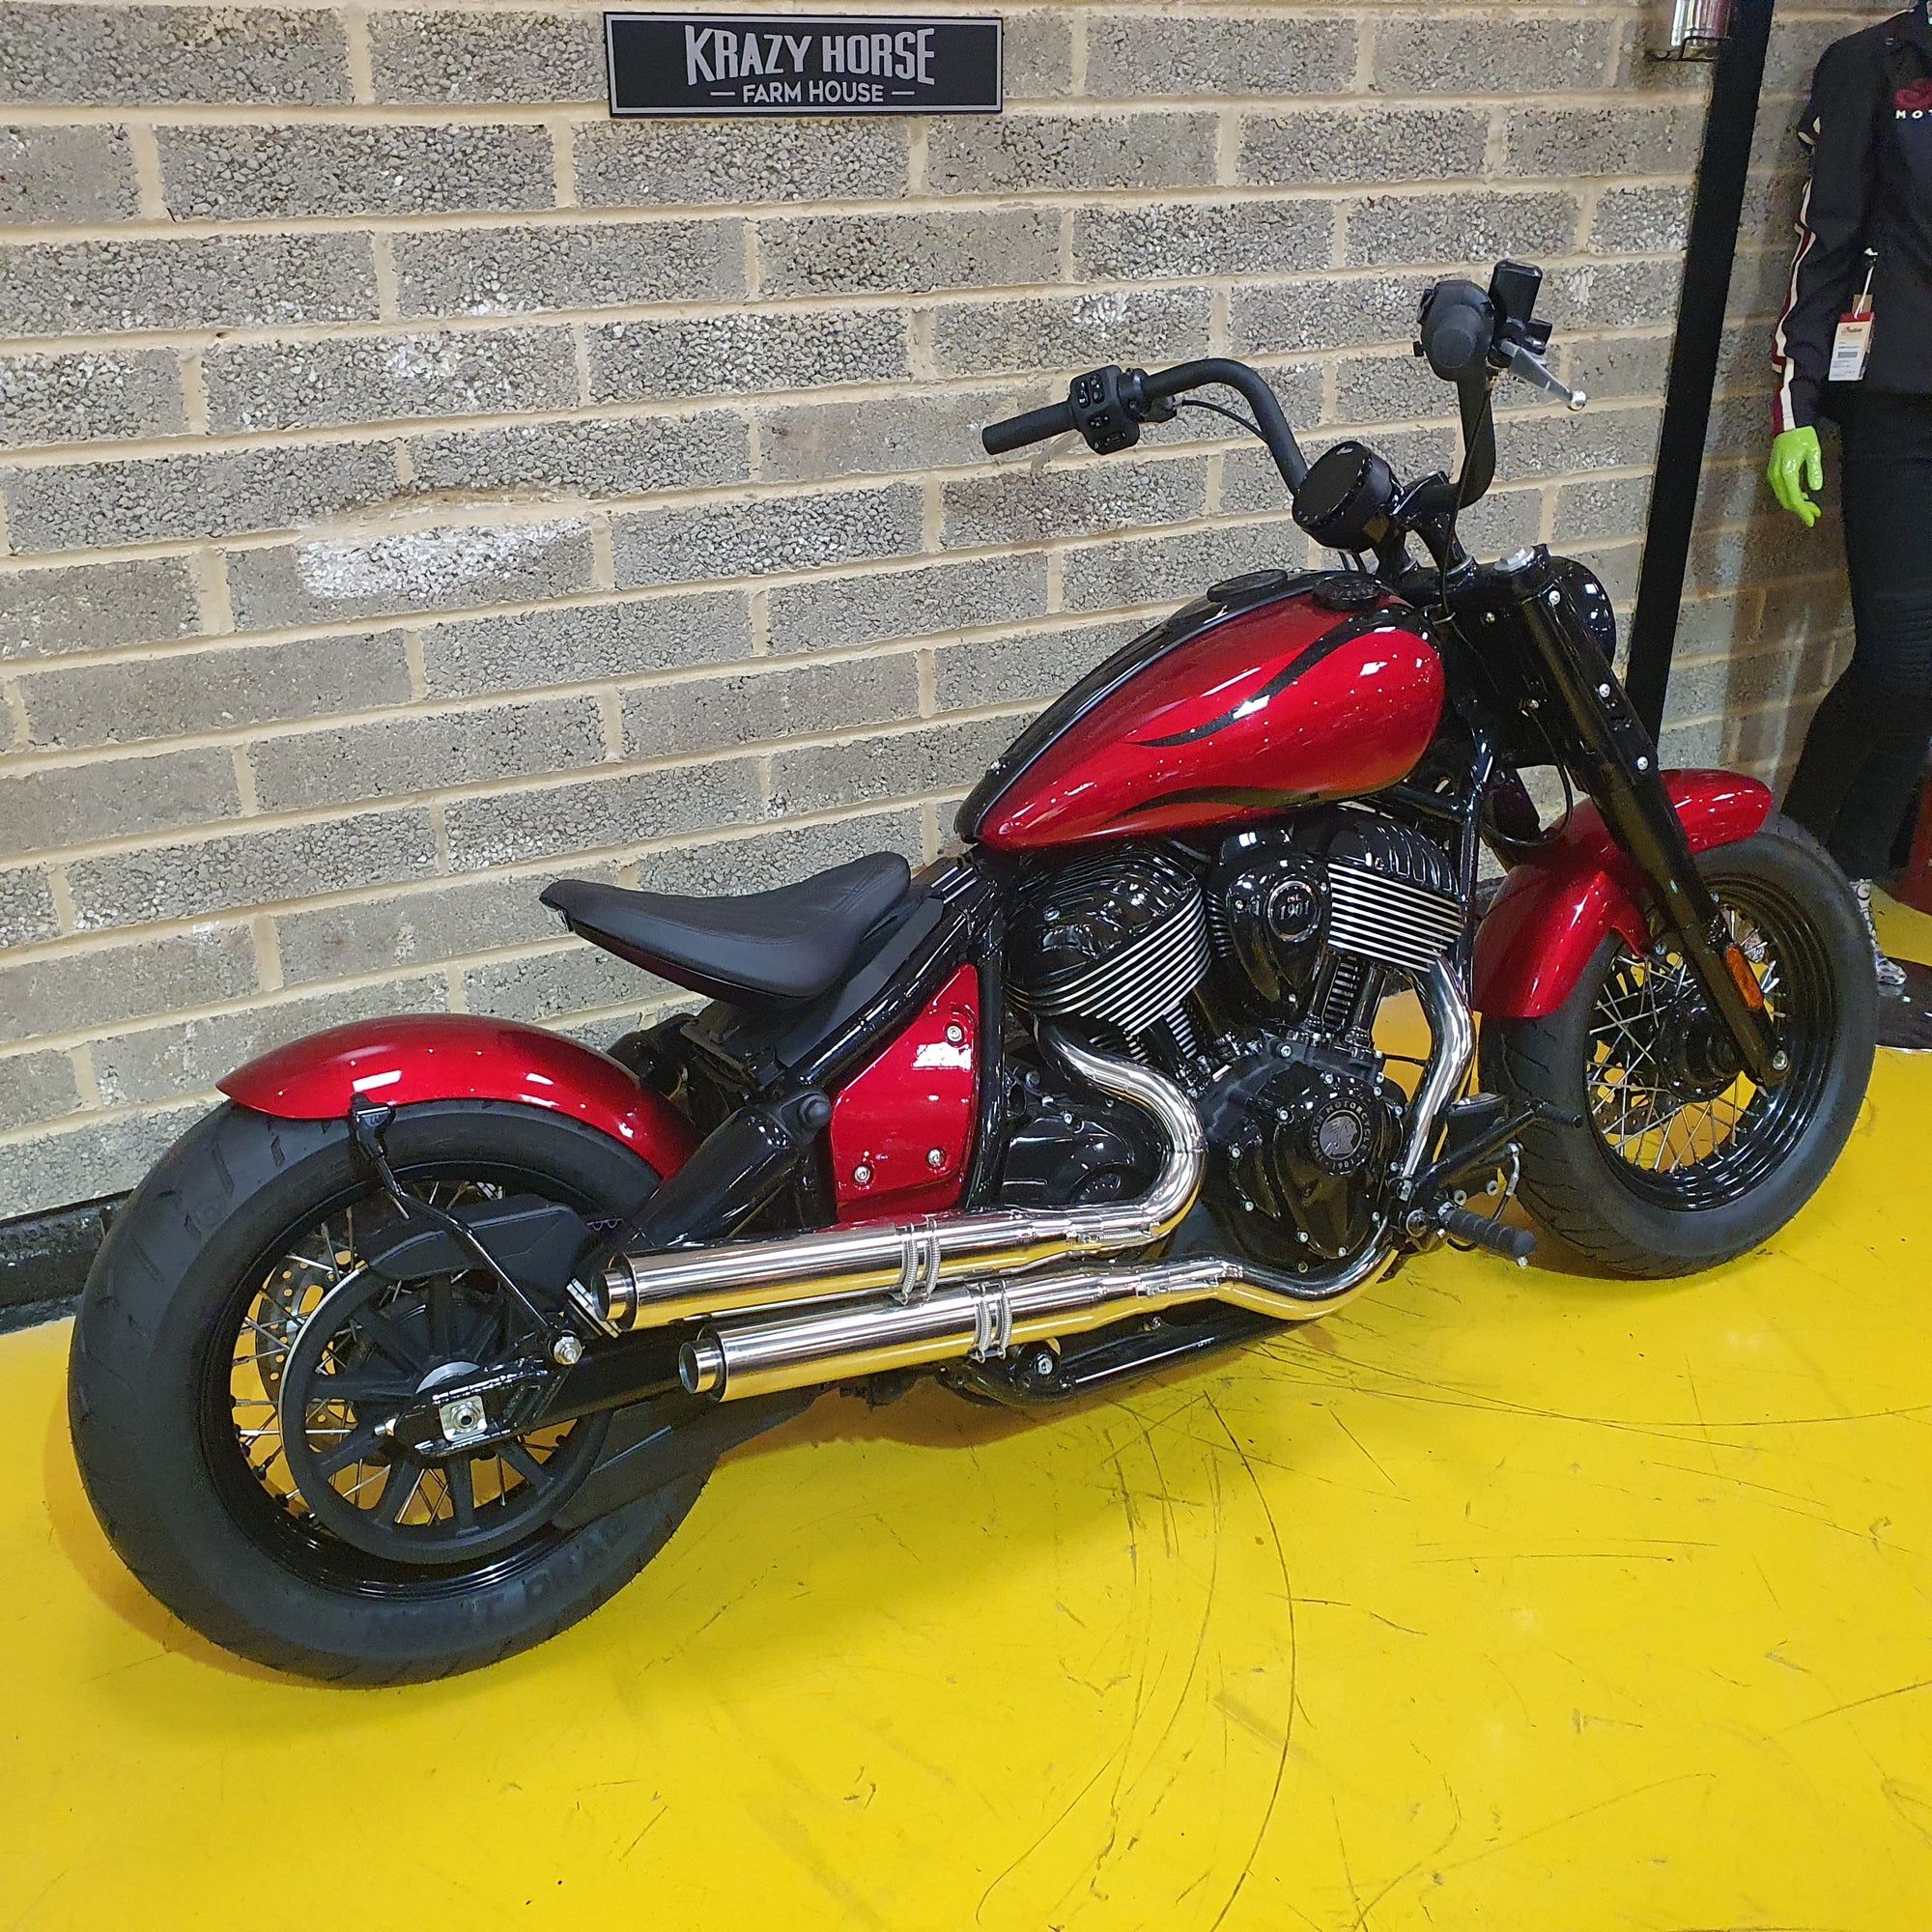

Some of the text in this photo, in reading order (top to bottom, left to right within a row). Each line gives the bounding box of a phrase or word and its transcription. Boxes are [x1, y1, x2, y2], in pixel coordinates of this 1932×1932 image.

[685, 25, 935, 85] KRAZY HORSE
[743, 80, 884, 102] FARM HOUSE
[1280, 900, 1310, 920] 1901
[1312, 1101, 1371, 1162] INDIAN MOTORCYCLE
